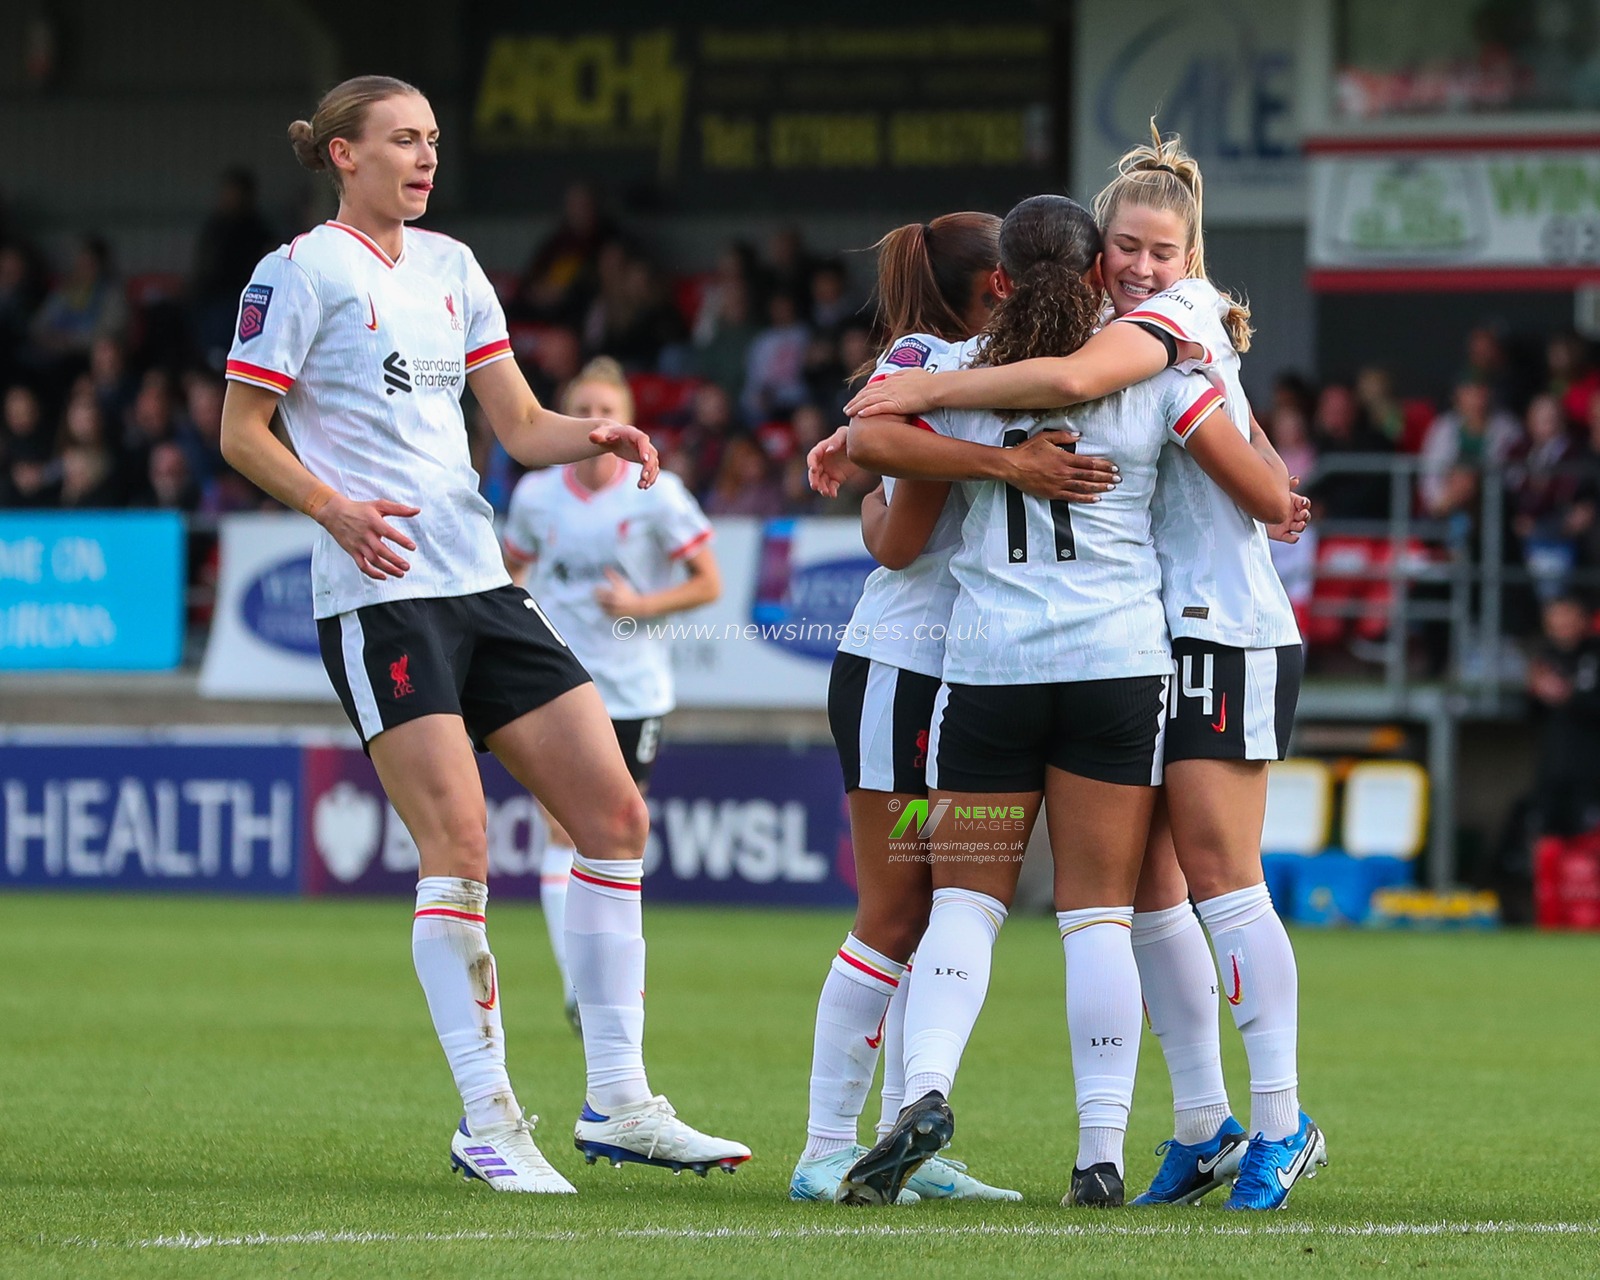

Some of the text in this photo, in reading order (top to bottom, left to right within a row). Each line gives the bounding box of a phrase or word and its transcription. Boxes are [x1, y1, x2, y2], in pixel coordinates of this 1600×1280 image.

[412, 357, 461, 373] standard
[4, 777, 293, 878] HEALTH
[664, 798, 830, 884] WSL
[935, 967, 968, 980] LFC
[1091, 1037, 1123, 1047] LFC
